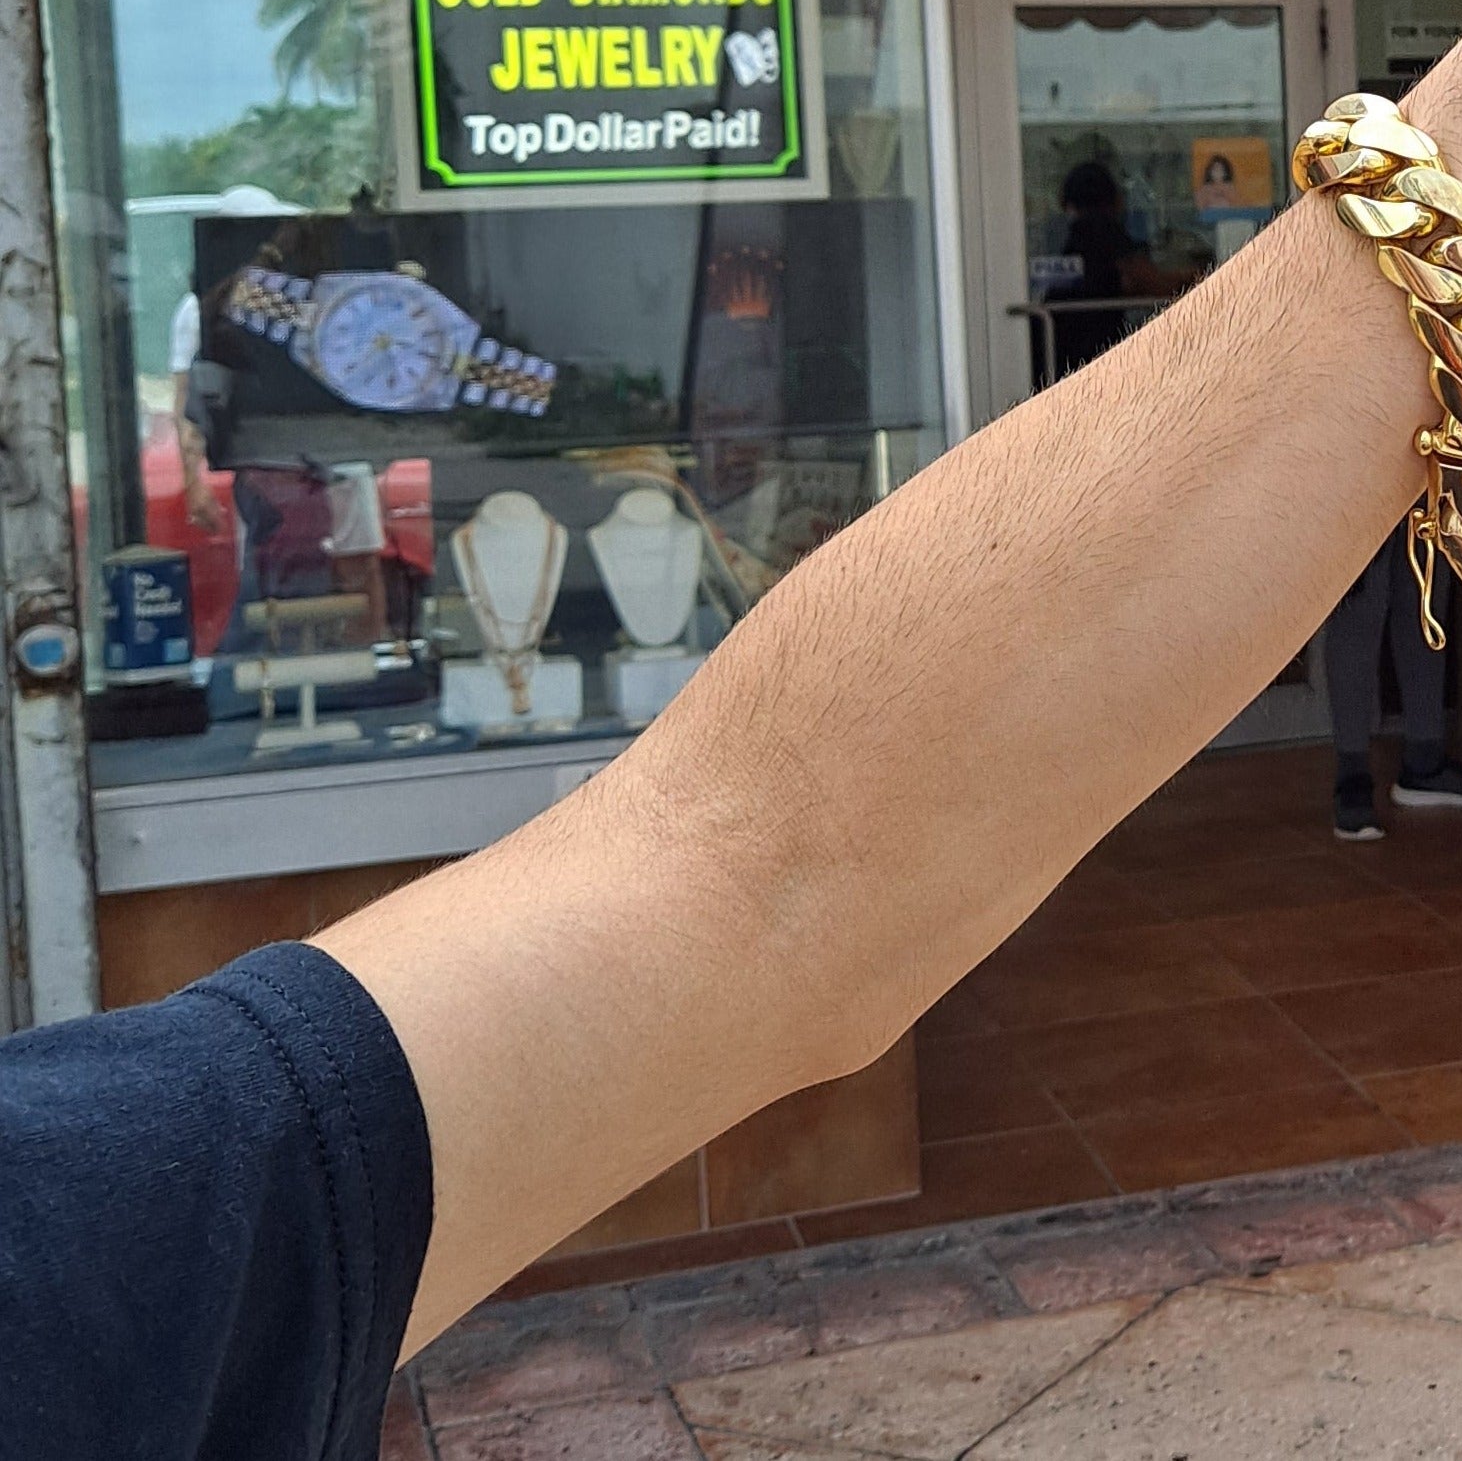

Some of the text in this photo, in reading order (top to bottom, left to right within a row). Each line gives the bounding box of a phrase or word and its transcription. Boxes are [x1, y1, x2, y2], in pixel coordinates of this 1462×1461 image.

[489, 26, 725, 91] JEWELRY
[463, 108, 762, 164] Top Dollar Paid!
